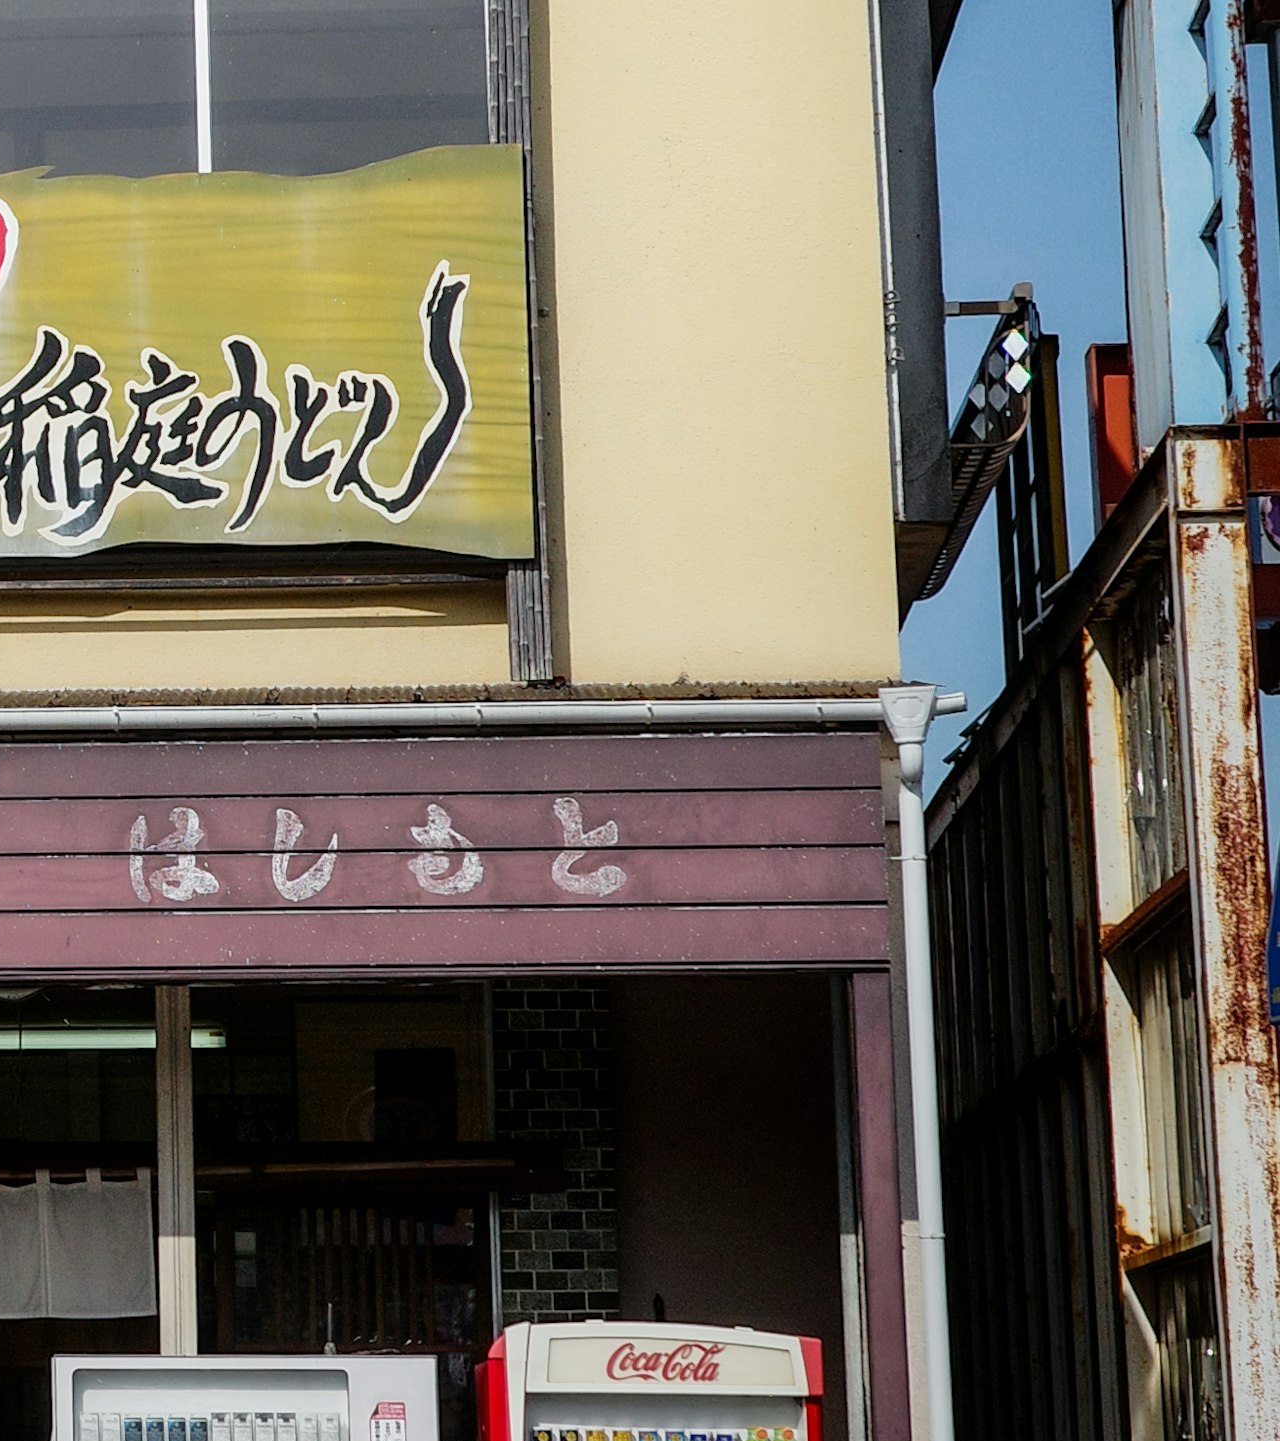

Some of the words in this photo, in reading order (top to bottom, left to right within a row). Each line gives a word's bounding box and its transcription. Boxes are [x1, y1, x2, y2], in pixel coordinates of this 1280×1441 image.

[129, 797, 627, 902] はしもと
[606, 1342, 726, 1382] Coca-Cola
